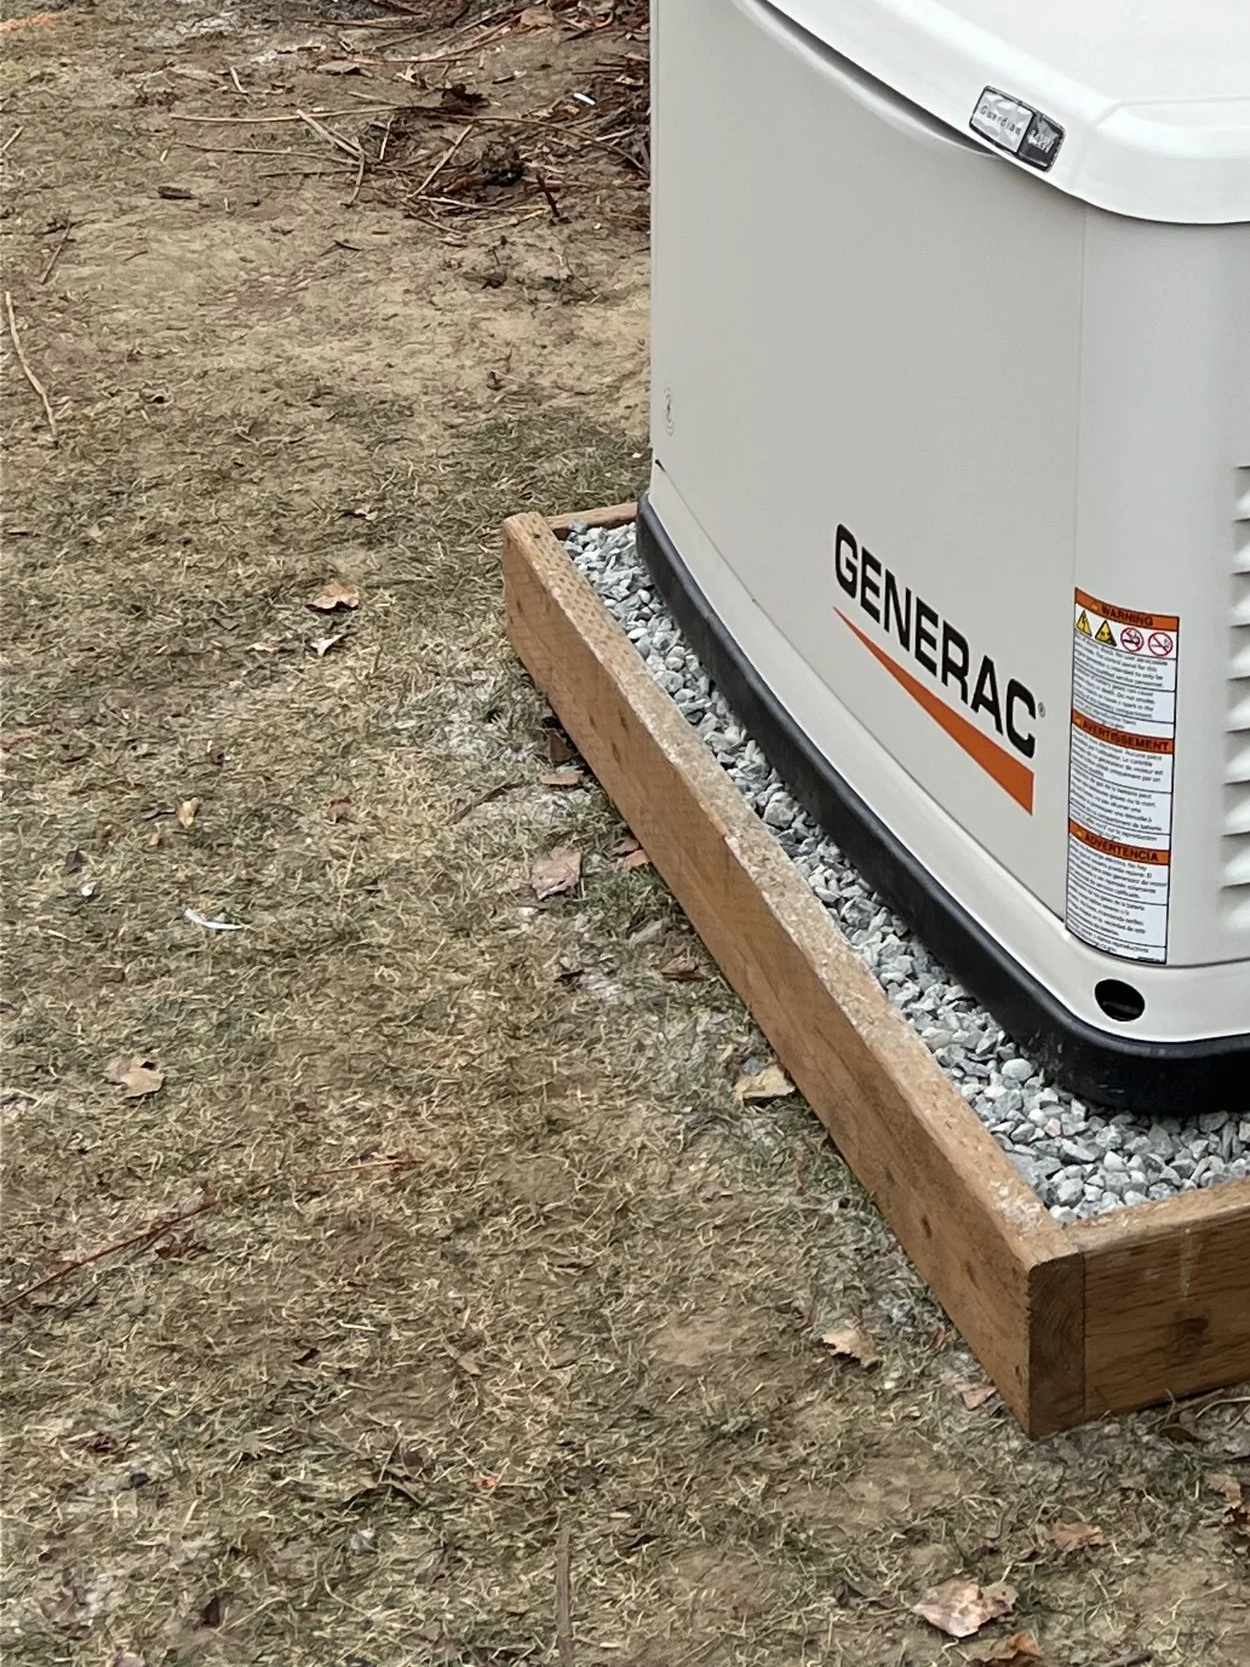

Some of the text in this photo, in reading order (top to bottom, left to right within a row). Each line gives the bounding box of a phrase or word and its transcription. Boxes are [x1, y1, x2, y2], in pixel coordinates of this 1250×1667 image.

[979, 104, 1022, 137] Guardian
[1101, 604, 1154, 627] WARNING
[835, 523, 1036, 759] GENERAC
[1082, 718, 1169, 751] AVERTISSEMENT
[1084, 833, 1158, 862] ADVERTENCIA
